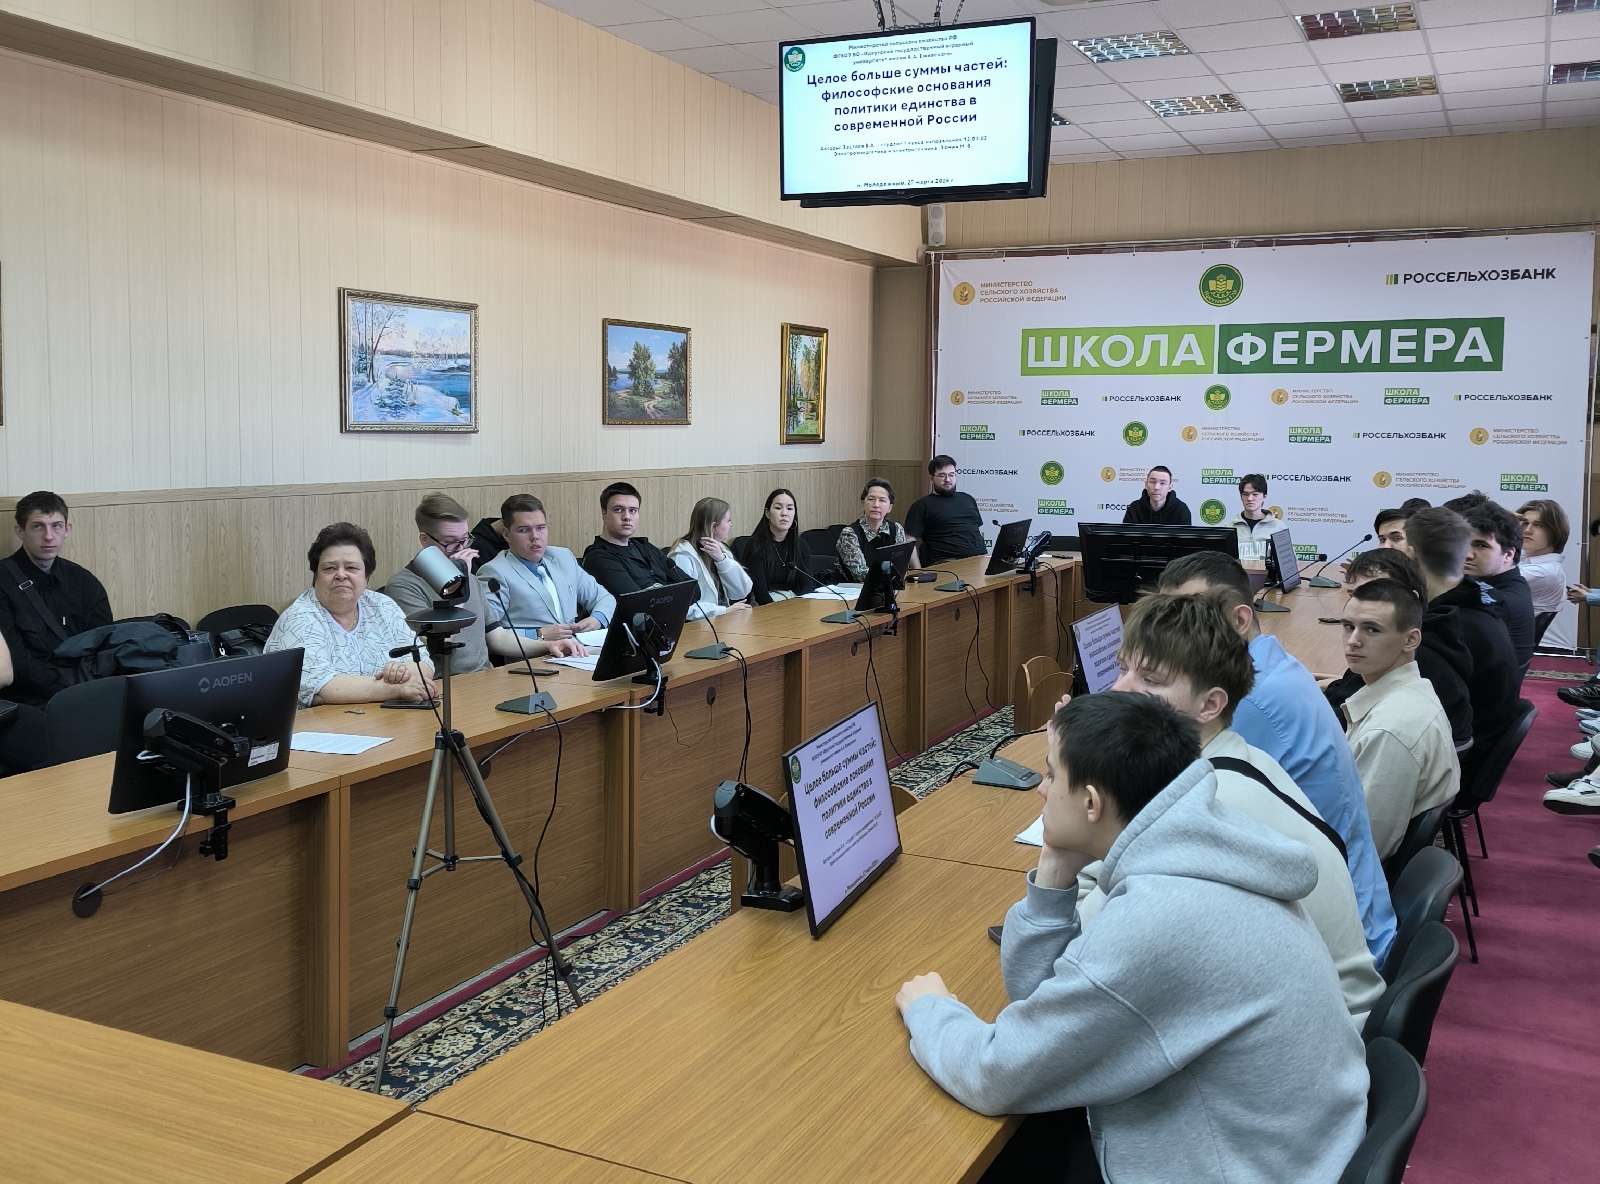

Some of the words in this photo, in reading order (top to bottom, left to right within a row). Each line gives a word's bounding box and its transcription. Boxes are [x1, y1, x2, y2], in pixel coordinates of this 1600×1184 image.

[807, 74, 847, 87] Целое
[851, 69, 901, 81] больше
[905, 65, 950, 78] суммы
[954, 57, 1007, 71] частей:
[821, 86, 913, 102] философские
[917, 79, 991, 92] основания
[834, 103, 897, 115] политики
[901, 98, 965, 112] единства
[969, 97, 977, 105] в
[834, 115, 922, 132] современной
[927, 114, 977, 125] России
[1403, 268, 1556, 284] РОССЕЛЬХОЗБАНК
[1027, 333, 1206, 368] ШКОЛА
[1226, 327, 1494, 366] ФЕРМЕРА
[1385, 388, 1419, 396] ШКОЛА
[1027, 429, 1095, 437] РОССЕЛЬХОЗБАНК
[1271, 474, 1352, 483] РОССЕЛЬХОЗБАНК
[1501, 474, 1537, 482] ШКОЛА
[655, 595, 674, 606] AOPEN
[212, 672, 253, 689] AOPEN
[804, 776, 822, 795] Целое
[821, 763, 843, 782] больше
[842, 751, 859, 769] суммы
[814, 776, 849, 810] философские
[849, 758, 875, 781] основания
[821, 797, 846, 822] политики
[846, 779, 870, 803] единства
[825, 803, 859, 839] современной
[858, 792, 876, 812] России
